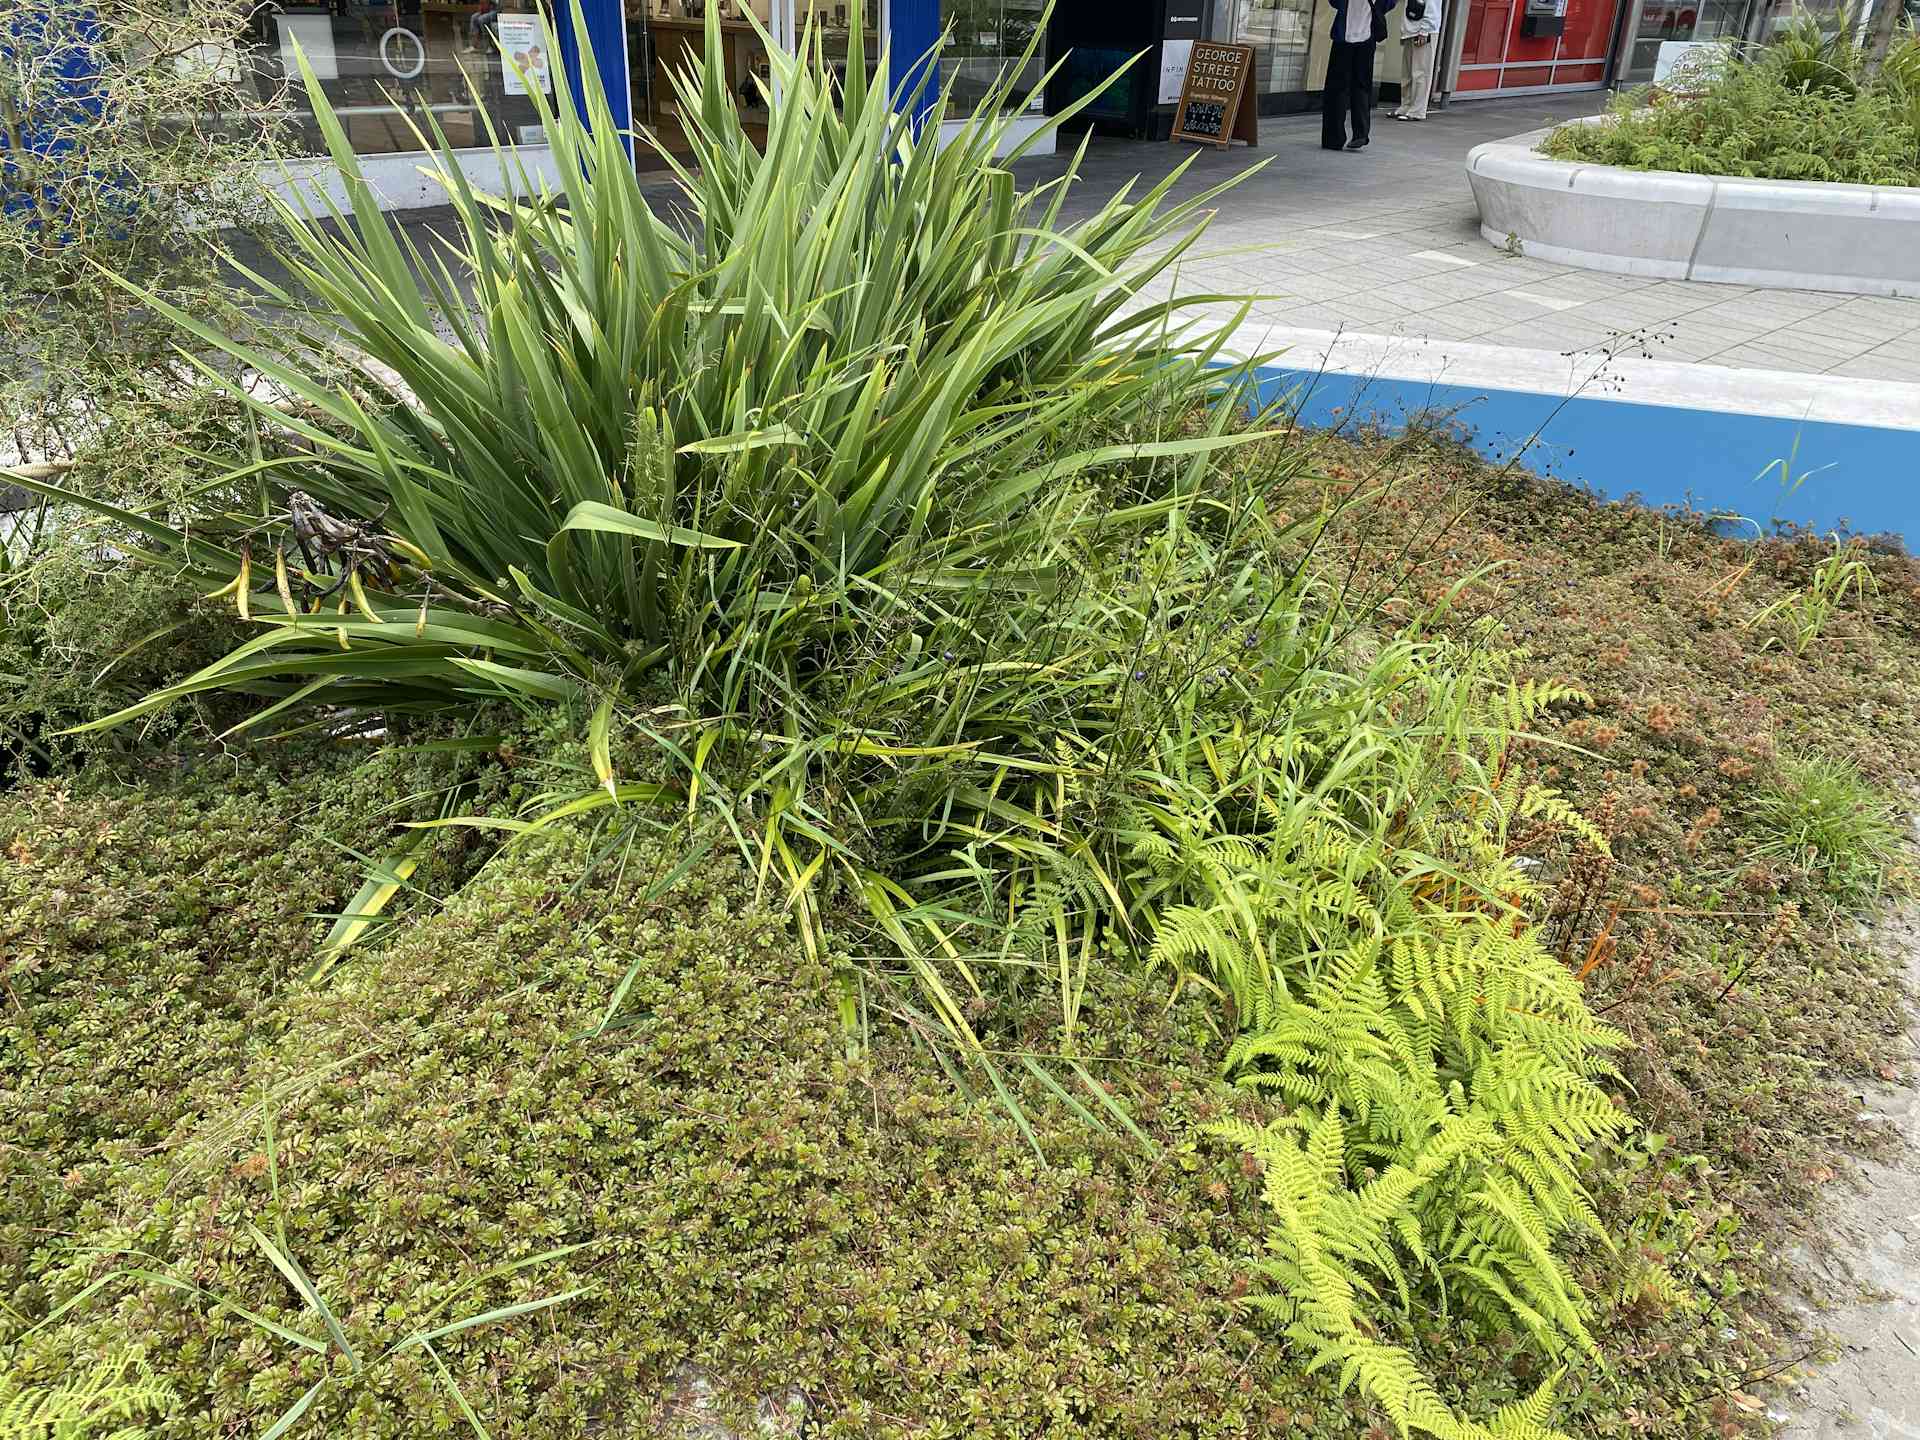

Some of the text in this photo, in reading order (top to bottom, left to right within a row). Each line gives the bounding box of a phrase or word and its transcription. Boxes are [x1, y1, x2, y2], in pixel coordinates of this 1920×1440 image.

[1196, 48, 1242, 64] GEORGE
[1193, 61, 1240, 78] STREET
[1191, 75, 1236, 92] TATTOO
